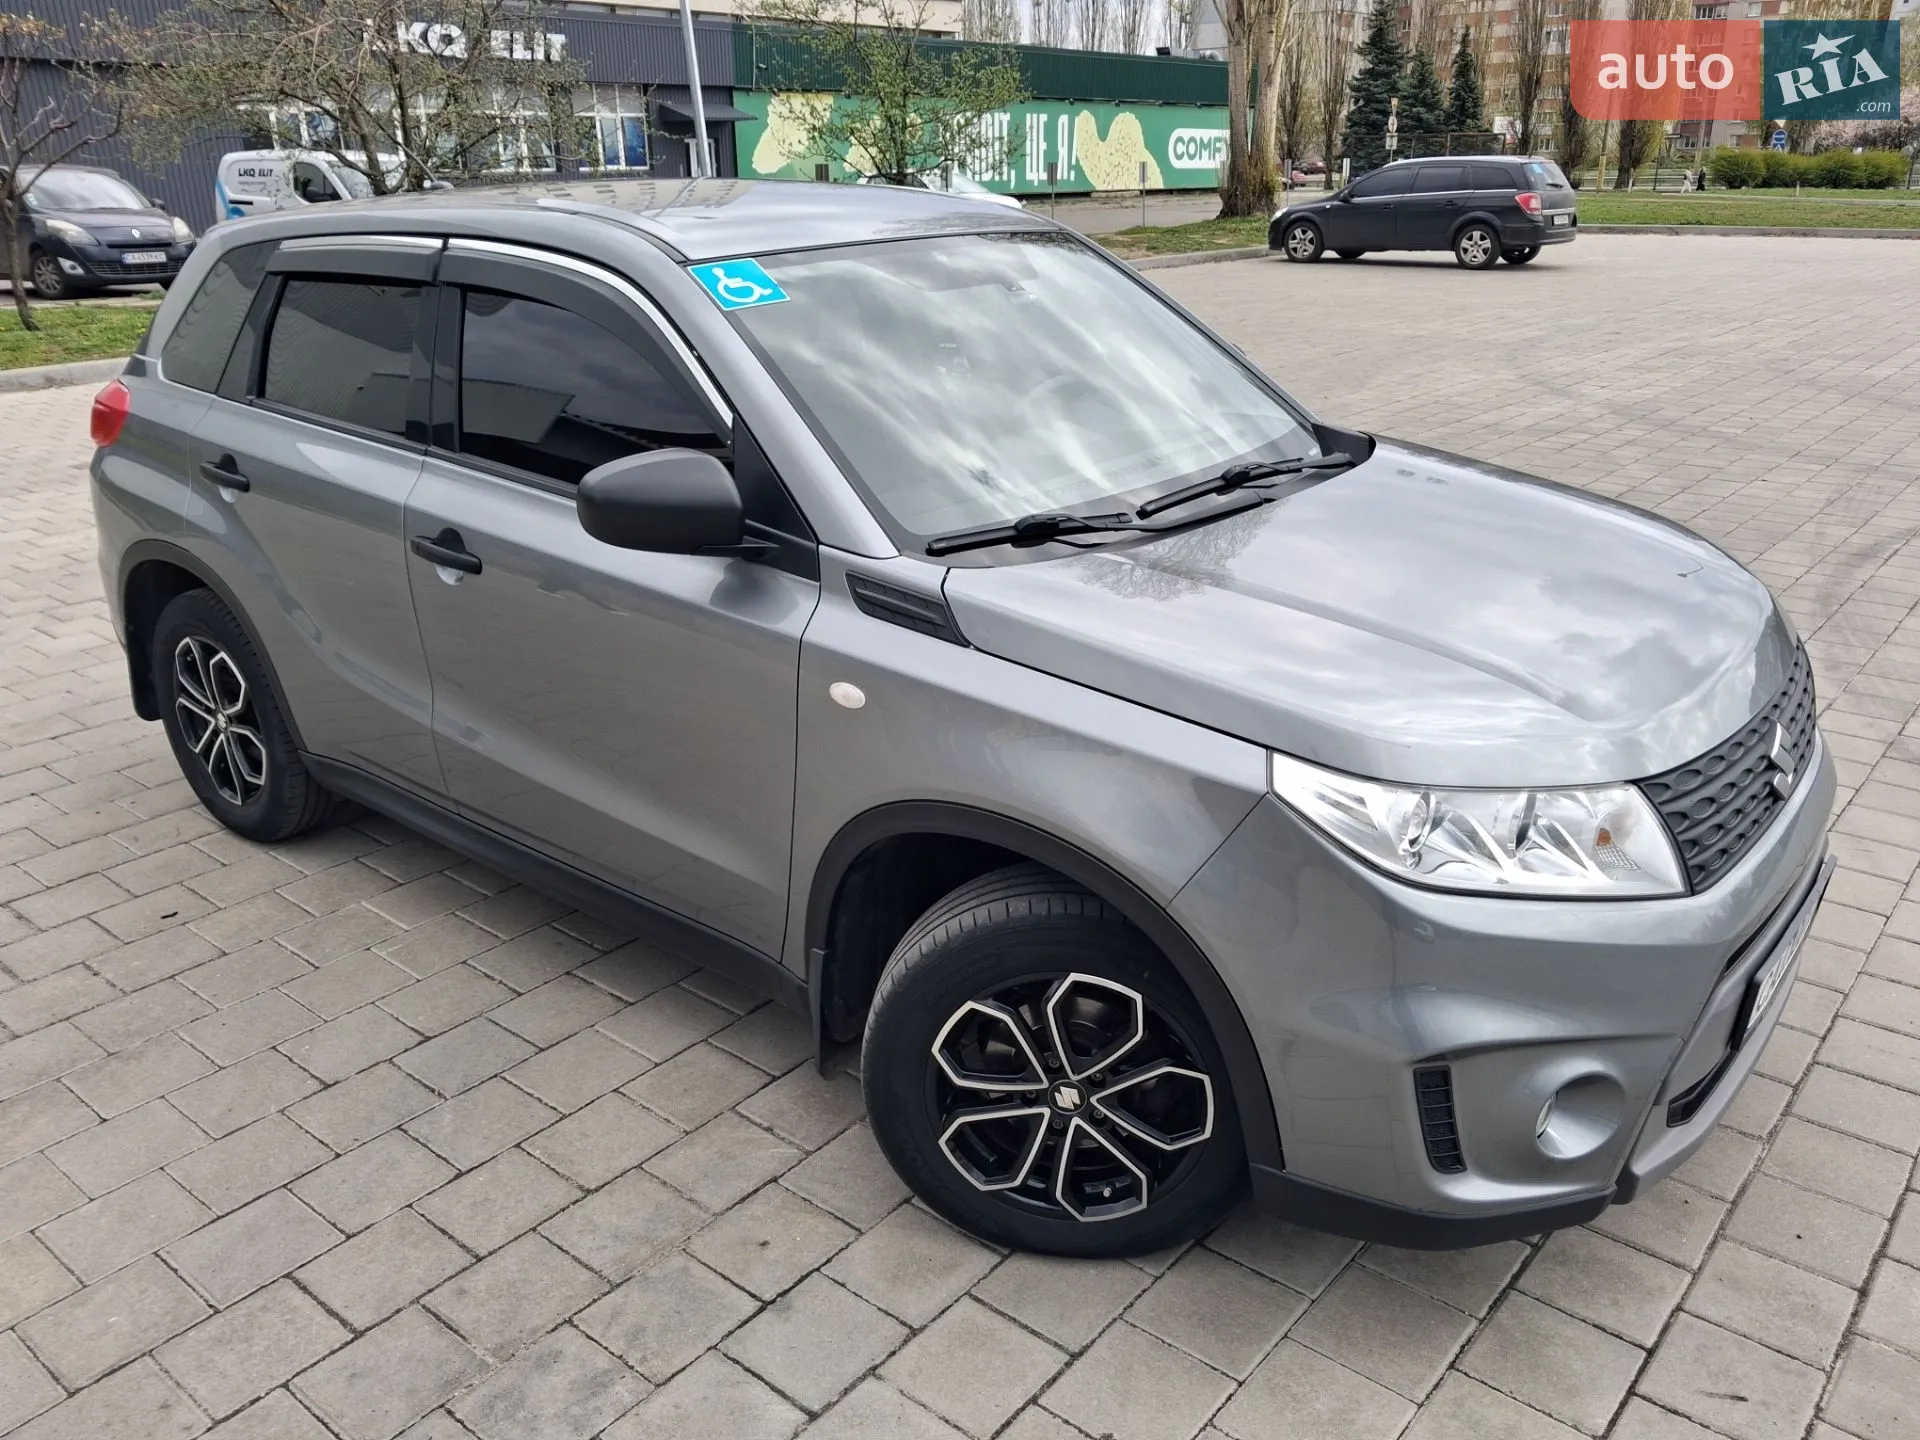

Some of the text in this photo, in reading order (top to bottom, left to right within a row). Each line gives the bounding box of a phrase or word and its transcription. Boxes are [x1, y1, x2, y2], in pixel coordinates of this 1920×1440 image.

[1025, 112, 1048, 186] ЦЕ
[1057, 113, 1079, 182] Я!
[238, 168, 256, 177] LKQ
